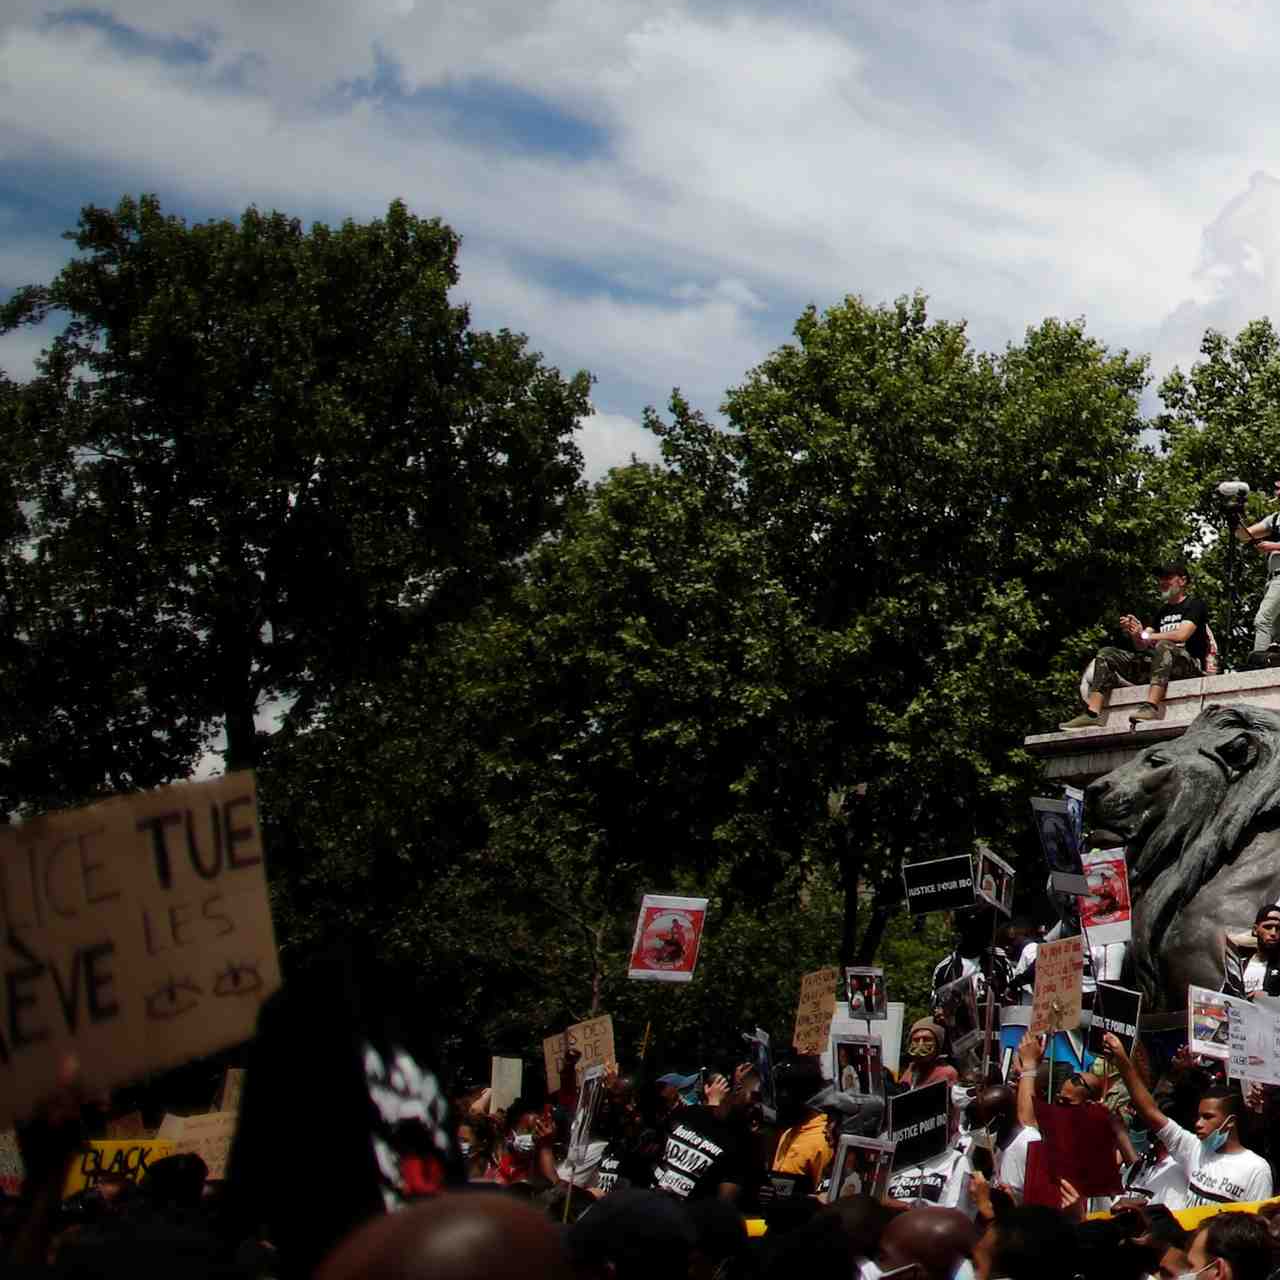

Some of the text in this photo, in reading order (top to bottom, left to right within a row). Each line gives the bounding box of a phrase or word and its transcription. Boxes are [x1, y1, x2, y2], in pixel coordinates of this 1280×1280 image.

[135, 794, 262, 891] TUE
[908, 884, 937, 898] JUSTICE
[142, 891, 237, 957] LES
[81, 1147, 153, 1175] BLACK
